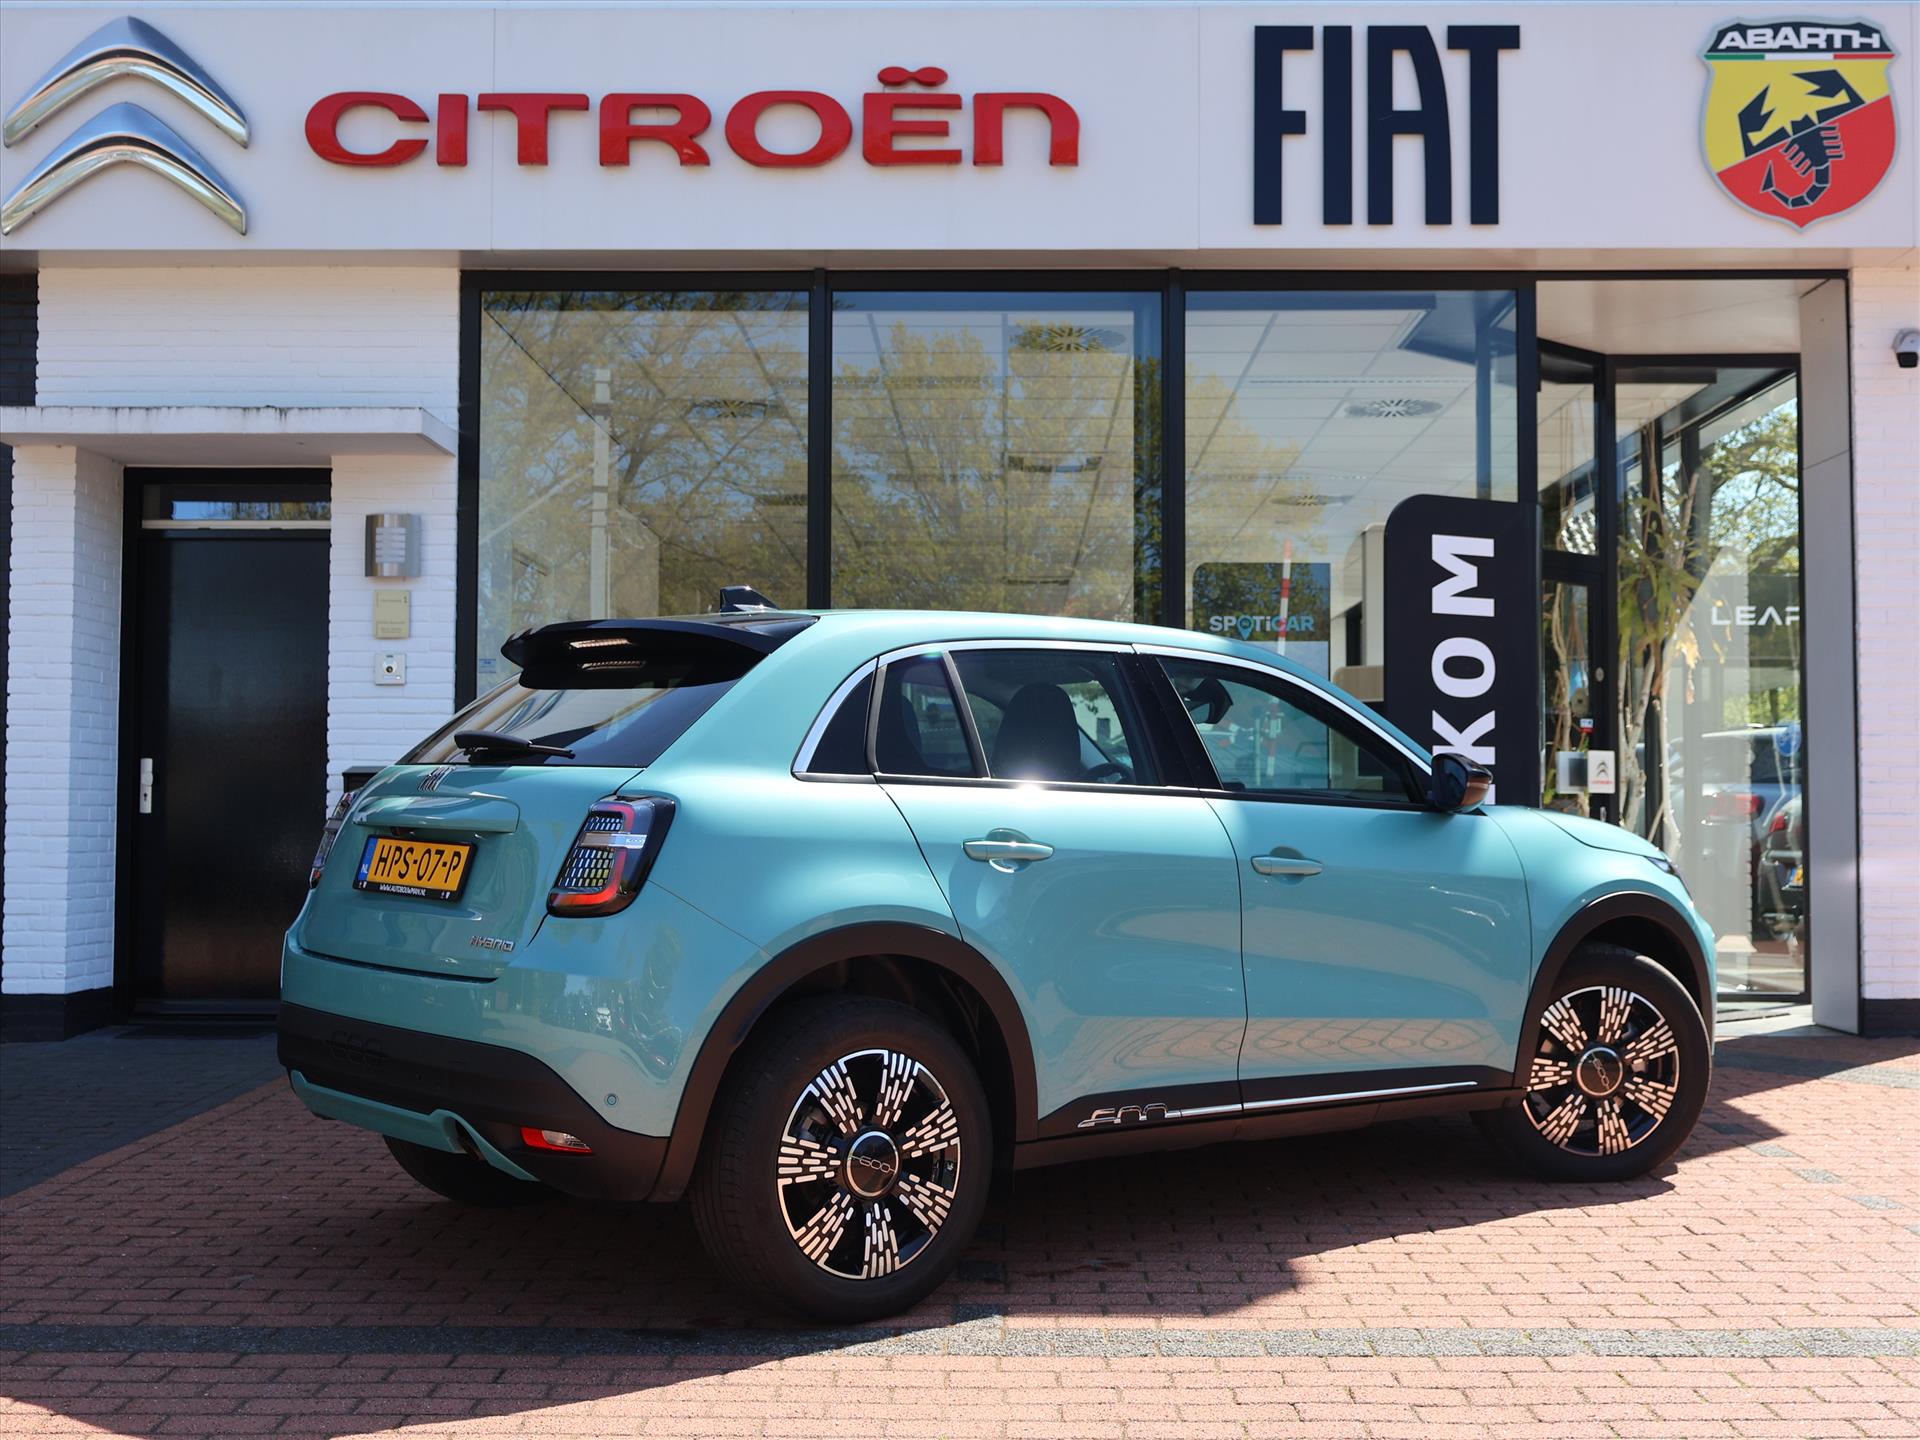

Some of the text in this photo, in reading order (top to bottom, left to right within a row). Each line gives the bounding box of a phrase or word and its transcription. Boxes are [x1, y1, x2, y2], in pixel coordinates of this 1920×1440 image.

[1717, 26, 1880, 49] ABARTH
[305, 66, 1080, 168] CITROËN
[1253, 25, 1520, 225] FIAT
[1431, 534, 1496, 805] KOM
[360, 863, 369, 874] NL
[373, 844, 462, 884] HPS-07-P
